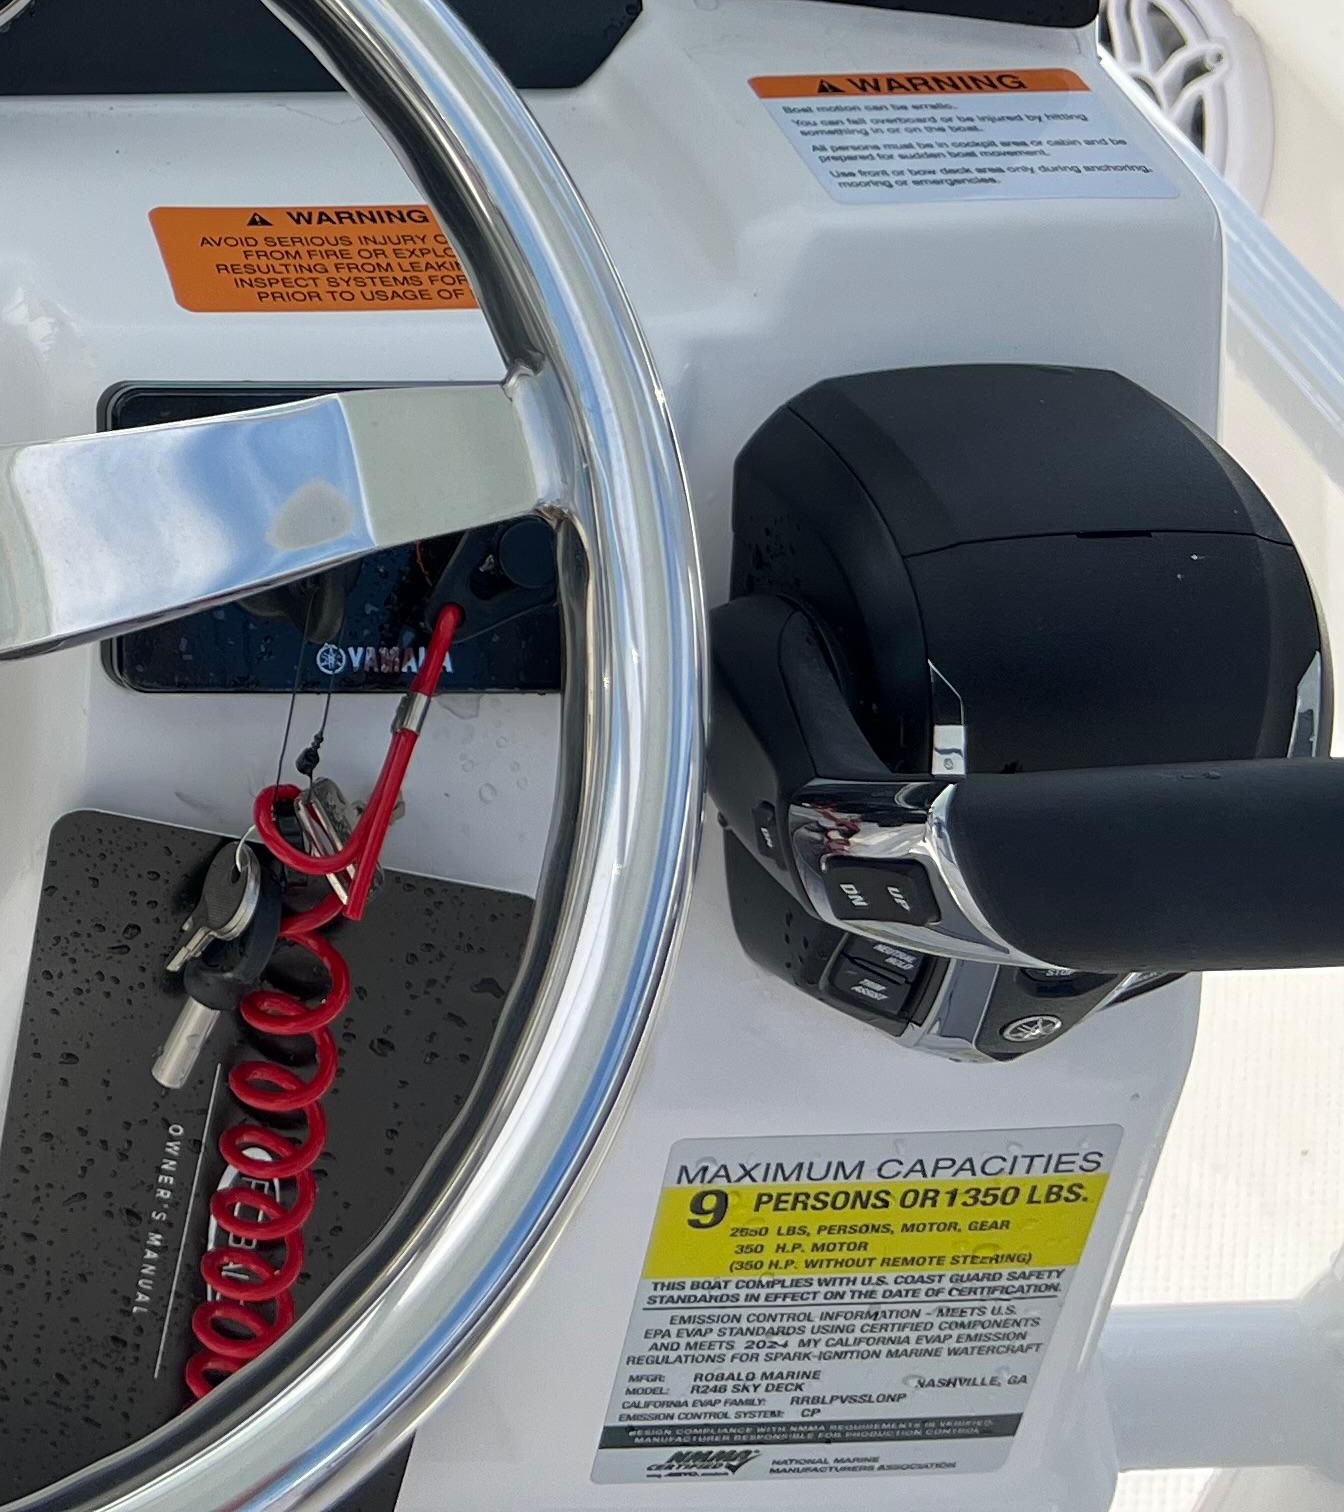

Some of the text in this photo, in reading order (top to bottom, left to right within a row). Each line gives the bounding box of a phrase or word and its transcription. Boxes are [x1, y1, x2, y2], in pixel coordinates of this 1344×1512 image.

[847, 74, 1027, 94] WARNING
[782, 106, 813, 114] Boat
[816, 104, 862, 113] motion
[864, 104, 889, 112] can
[889, 102, 908, 111] be
[286, 209, 429, 226] WARNING
[200, 234, 428, 248] AVOID SERIOUS INJURY
[243, 246, 456, 261] FROM FIRE OR EXPLO
[216, 260, 463, 275] RESULTING FROM LEAKI
[234, 276, 322, 289] INSPECT
[326, 275, 424, 288] SYSTEMS
[257, 288, 465, 303] PRIOR TO USAGE OF
[348, 646, 454, 673] YAMAA
[840, 883, 911, 912] DN UP
[151, 1124, 184, 1221] OWNER'S
[676, 1151, 1104, 1185] MAXIMUM CAPACITIES
[687, 1182, 1088, 1229] 9 PERSONS OR 1350 LBS.
[776, 1225, 810, 1238] LBS,
[816, 1223, 895, 1236] PERSONS,
[967, 1220, 1010, 1232] GEAR
[734, 1241, 868, 1255] 350 H.P. MOTOR
[729, 1253, 1033, 1273] (350 H.P. WITHOUT REMOTE STEERING)
[132, 1231, 163, 1314] MANUAL
